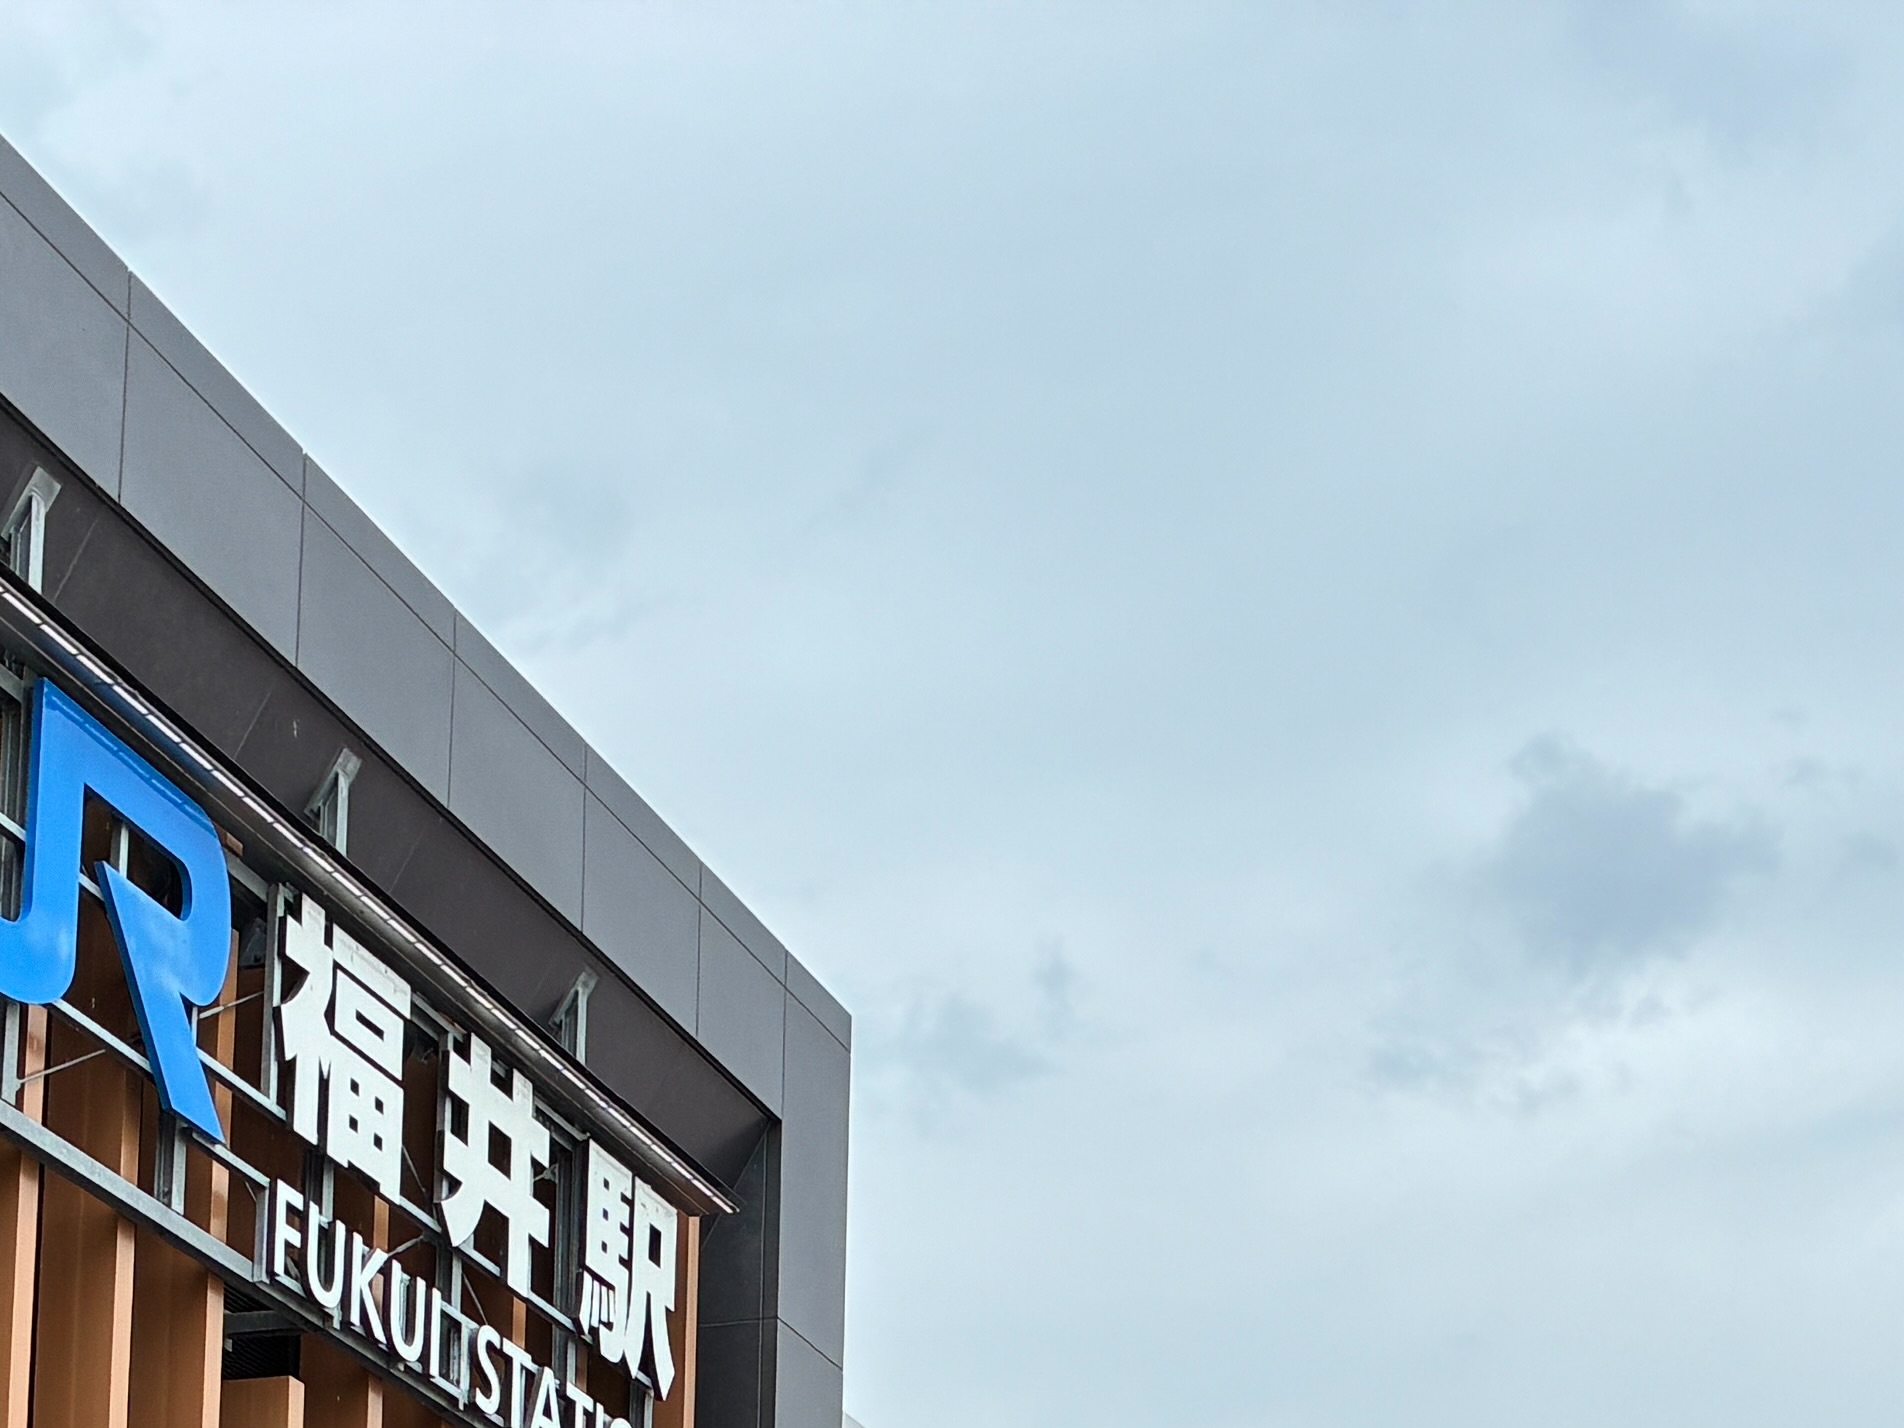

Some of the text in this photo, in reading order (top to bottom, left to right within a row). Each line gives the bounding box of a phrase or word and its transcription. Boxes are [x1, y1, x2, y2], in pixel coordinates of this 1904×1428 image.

[272, 1178, 443, 1379] FUKUI
[275, 893, 677, 1401] 福井駅
